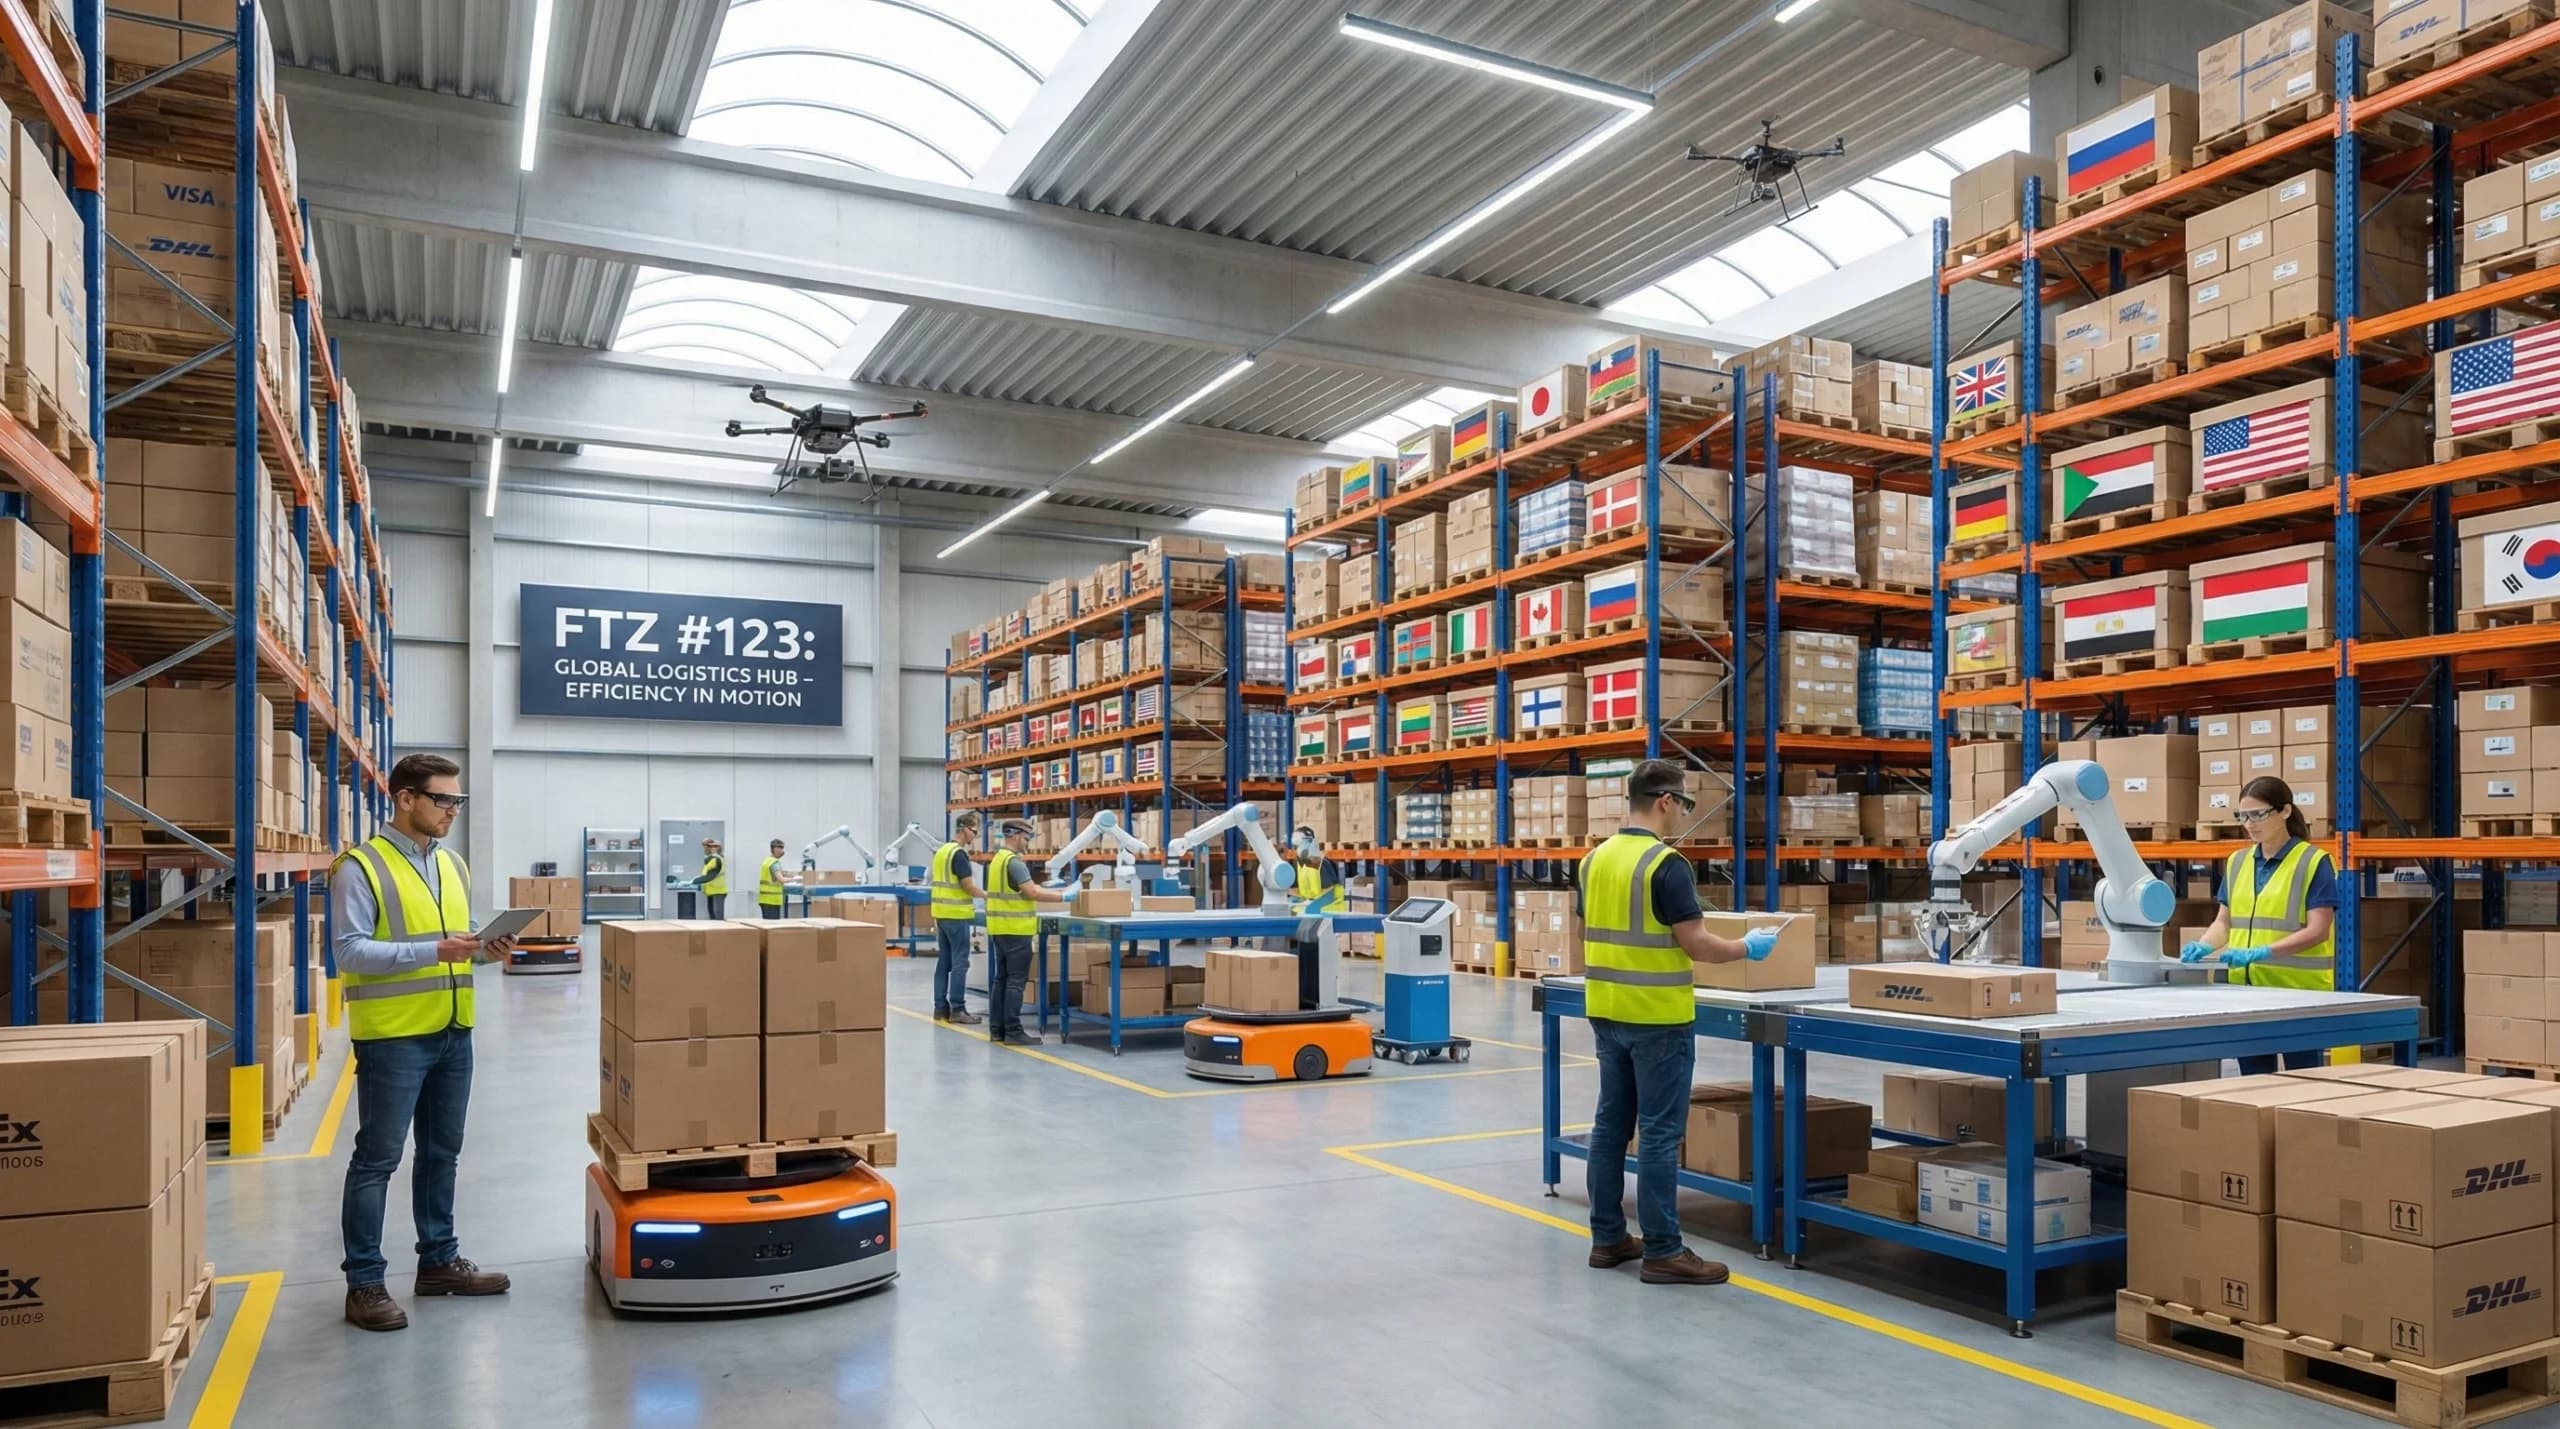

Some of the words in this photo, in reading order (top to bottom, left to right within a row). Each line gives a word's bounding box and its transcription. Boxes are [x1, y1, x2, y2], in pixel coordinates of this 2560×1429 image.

[162, 183, 215, 206] VISA
[149, 237, 215, 258] DHL
[555, 607, 659, 652] FTZ
[677, 614, 815, 661] #123:
[554, 659, 641, 679] GLOBAL
[646, 663, 751, 683] LOGISTICS
[756, 669, 798, 685] HUB
[565, 682, 687, 703] EFFICIENCY
[693, 687, 713, 703] IN
[720, 689, 802, 707] MOTION
[1884, 984, 1925, 1001] DHL
[2464, 1159, 2530, 1196] DHL
[2464, 1275, 2531, 1315] DHL
